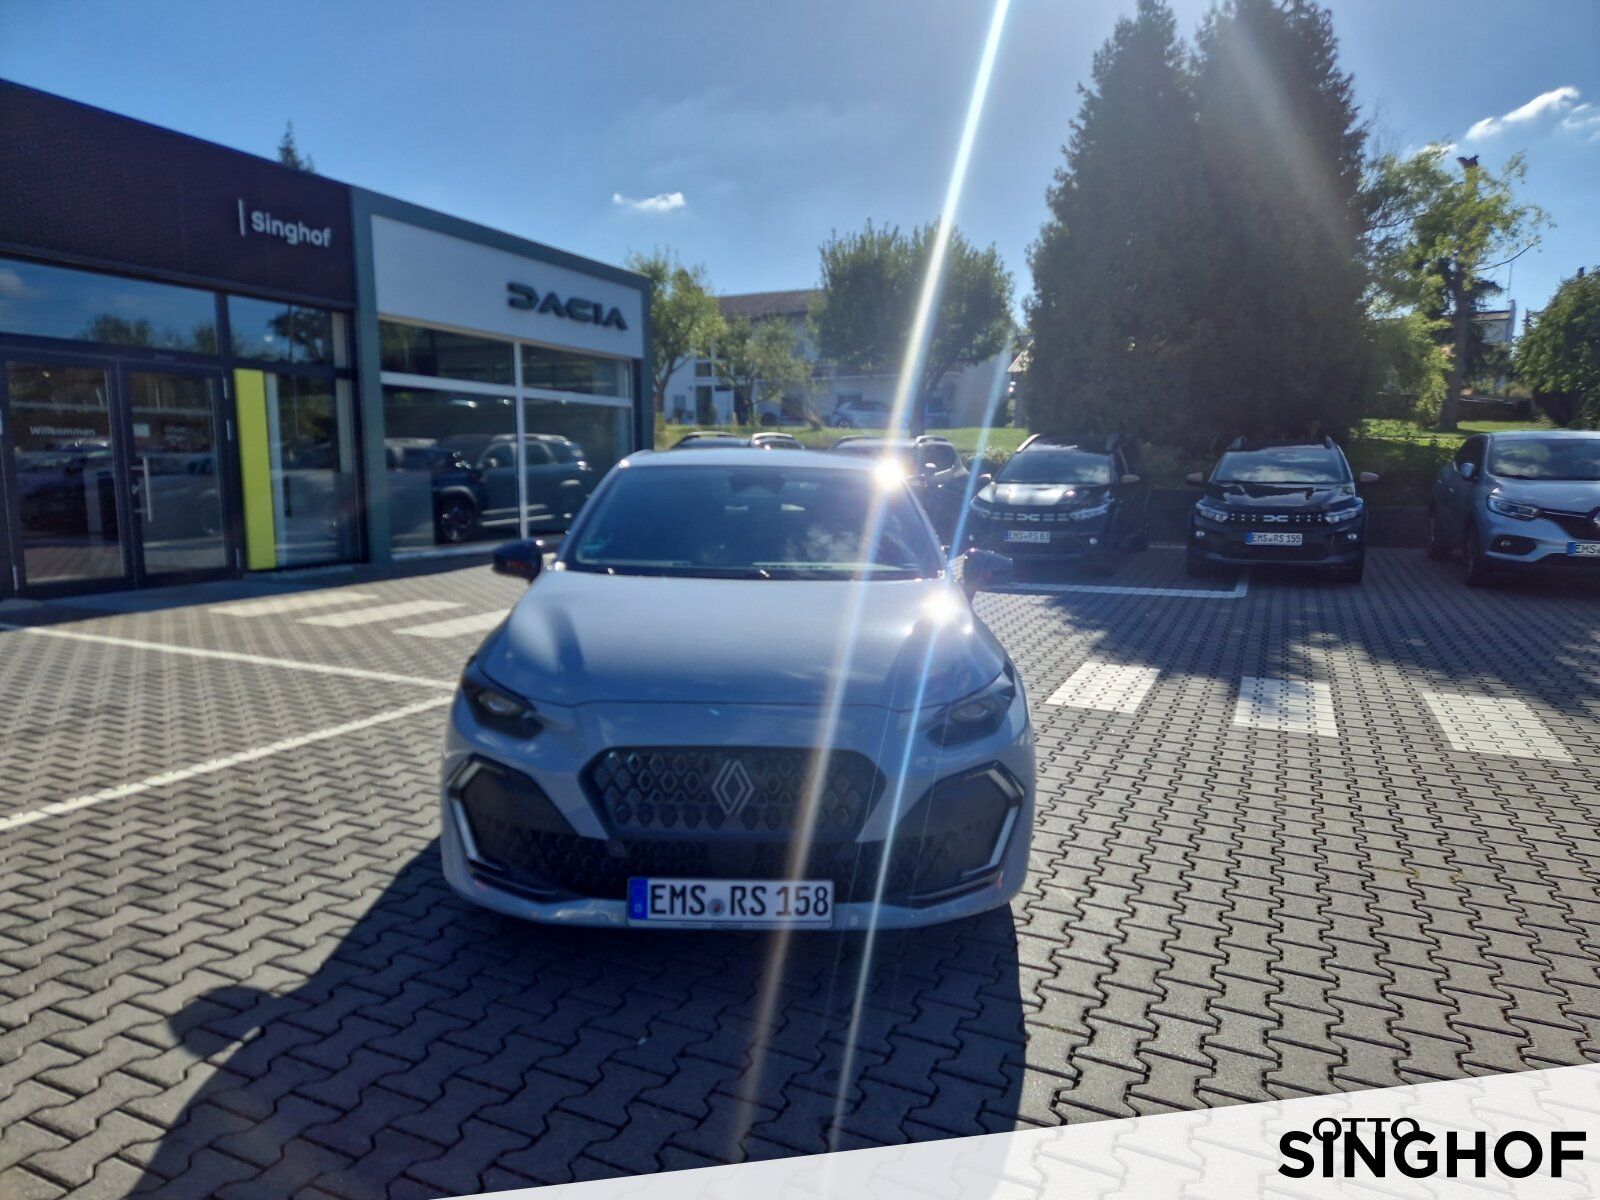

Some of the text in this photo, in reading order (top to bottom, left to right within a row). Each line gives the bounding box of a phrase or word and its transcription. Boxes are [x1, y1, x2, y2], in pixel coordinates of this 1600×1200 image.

[250, 210, 332, 248] Singhof
[506, 281, 628, 331] DACIA
[29, 425, 96, 436] Willkommen
[1252, 534, 1302, 543] EMS RS 155
[1575, 544, 1596, 554] EMS
[650, 884, 706, 916] EMS
[729, 886, 767, 917] RS
[775, 886, 830, 917] 158
